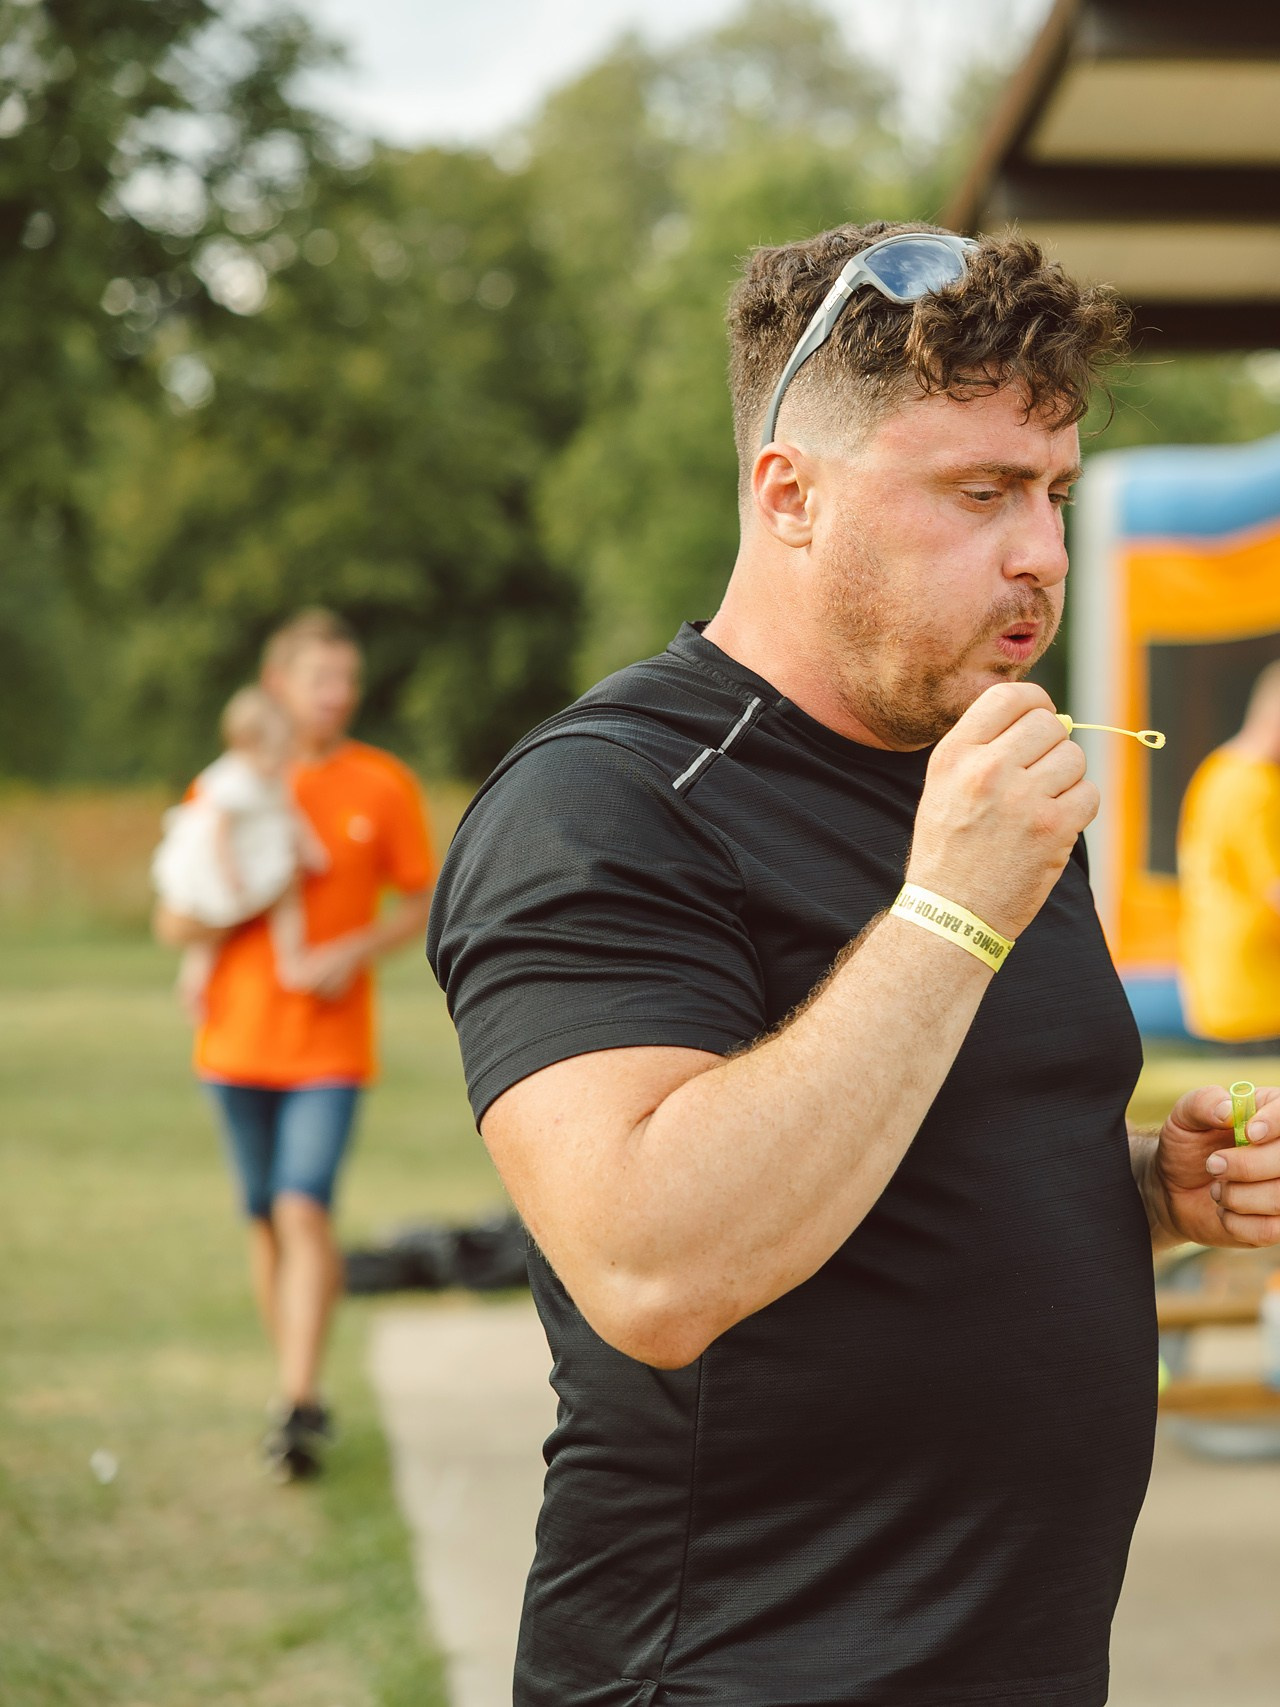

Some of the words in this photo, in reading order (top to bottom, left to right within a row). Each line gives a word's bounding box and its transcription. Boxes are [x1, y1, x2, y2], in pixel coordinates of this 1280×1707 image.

[914, 901, 963, 933] RAPTOR
[963, 923, 975, 937] &
[972, 930, 1005, 959] OCMC
